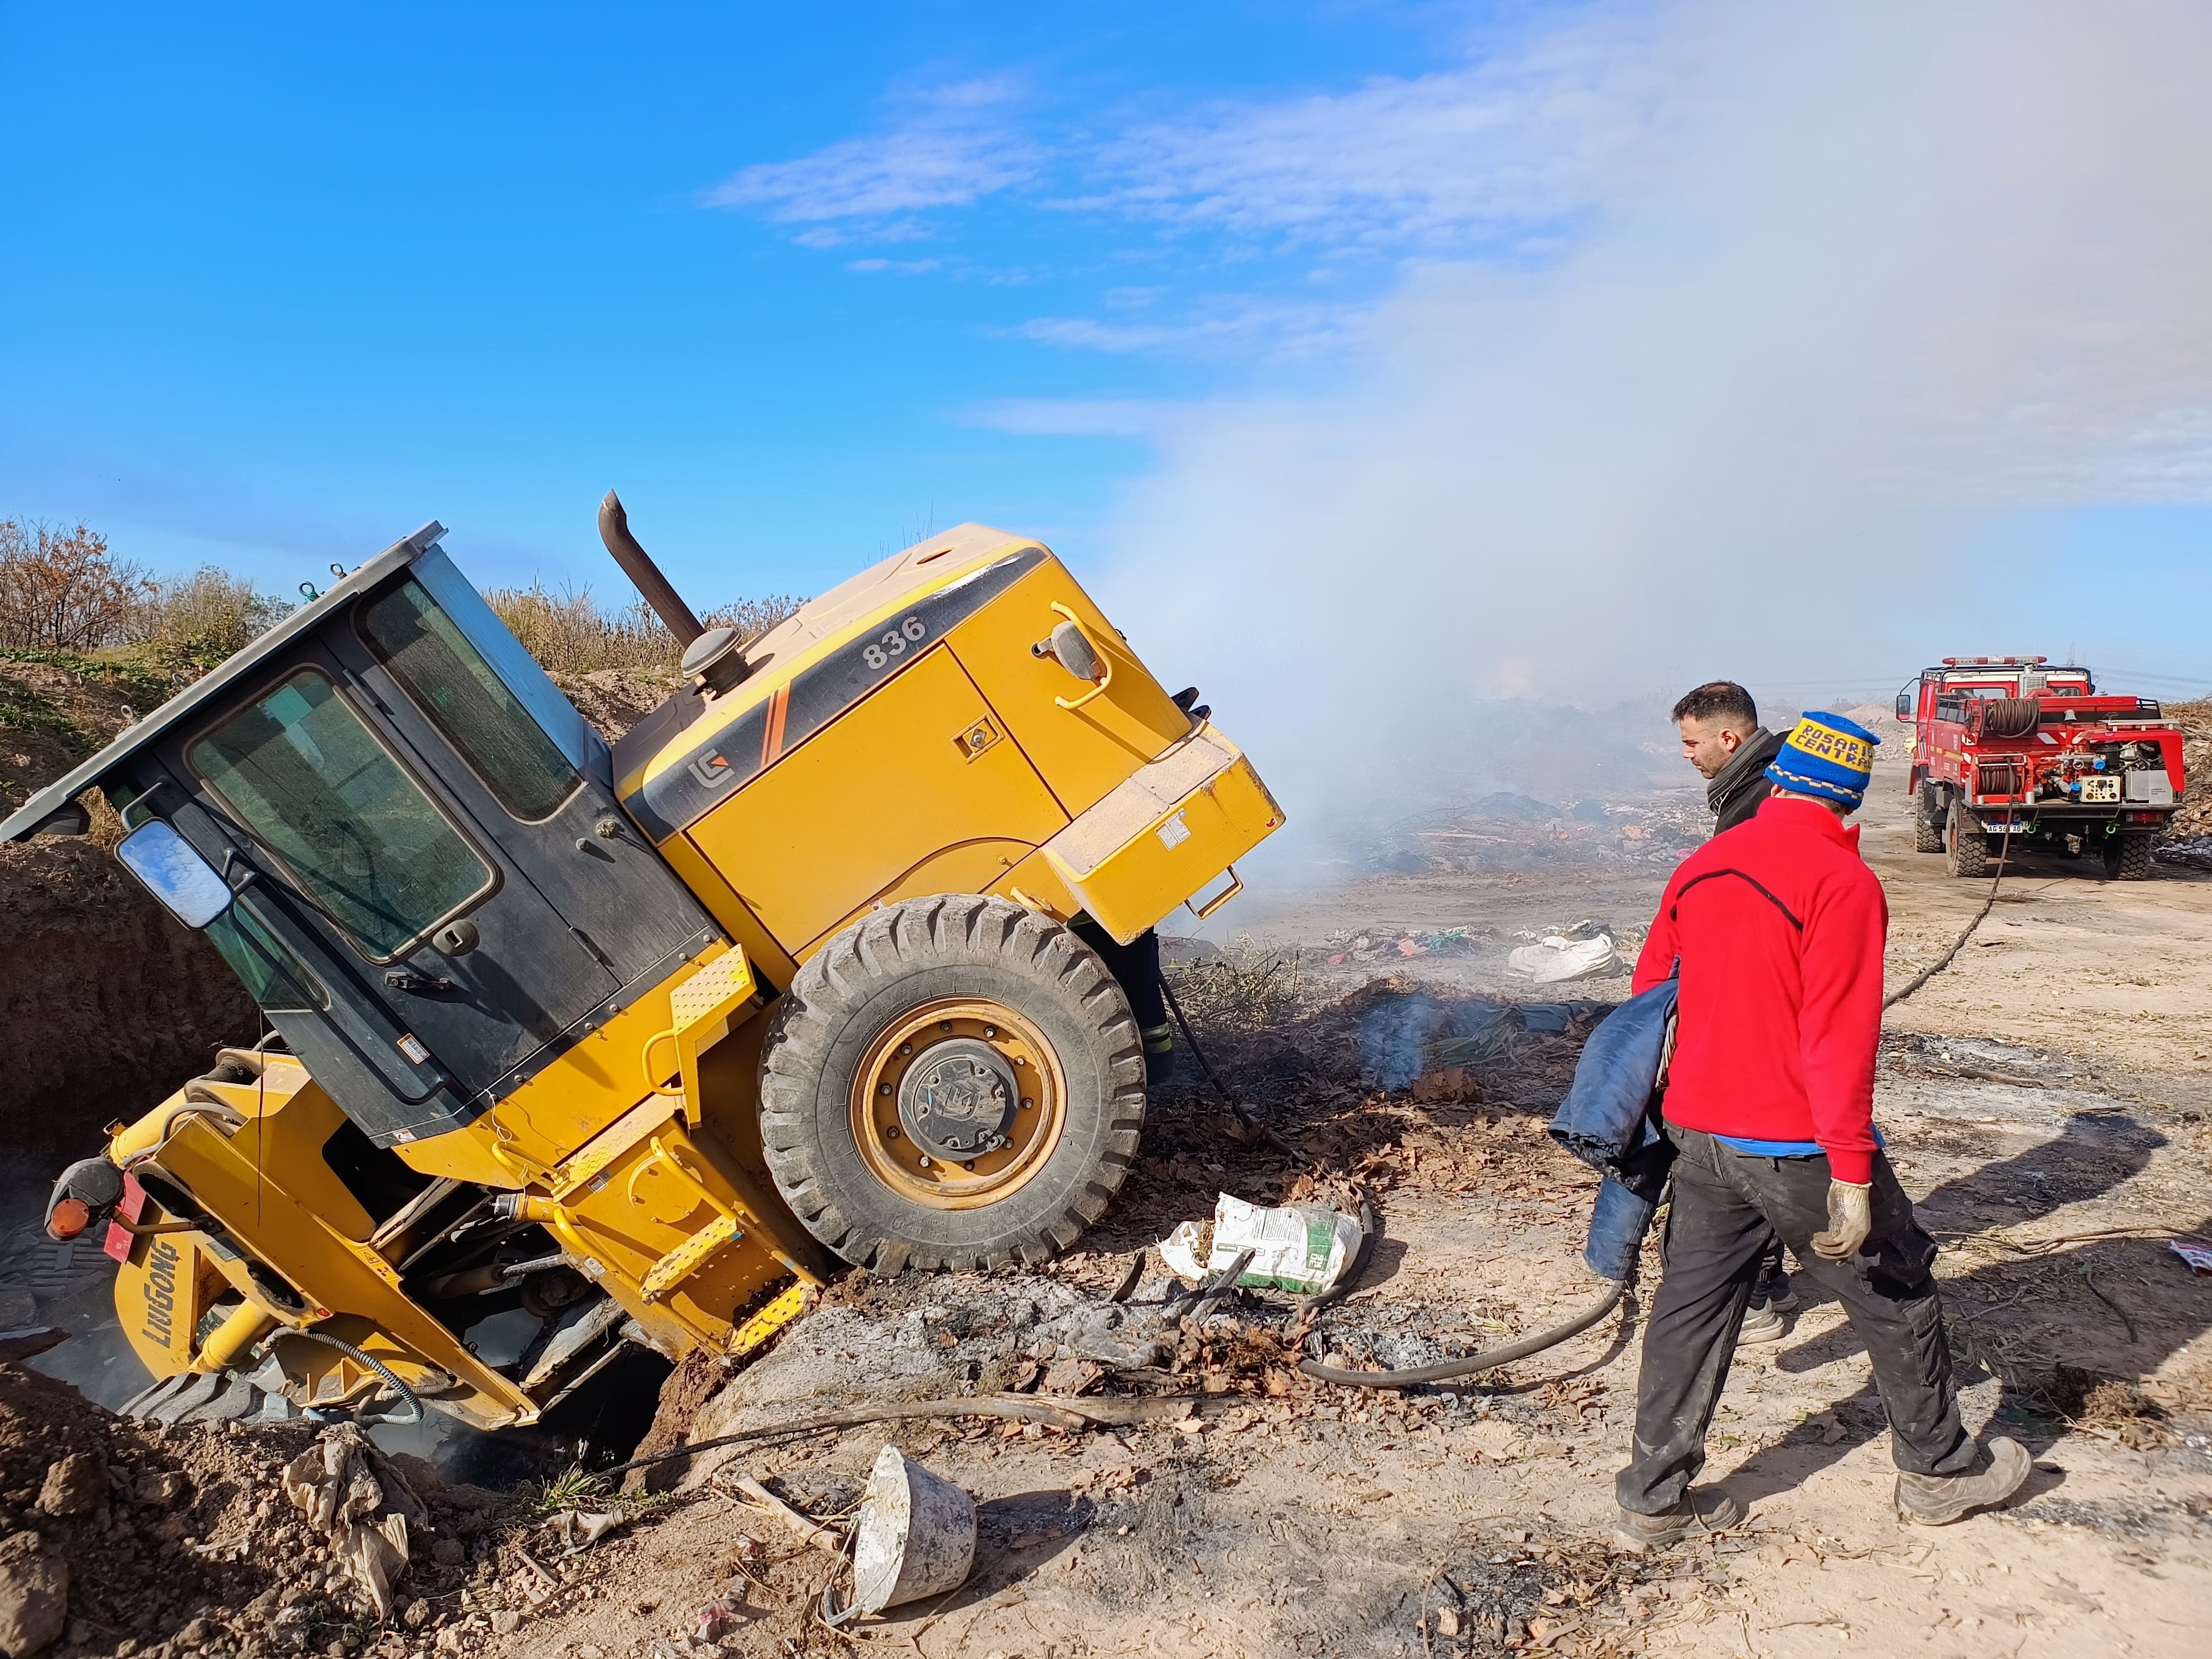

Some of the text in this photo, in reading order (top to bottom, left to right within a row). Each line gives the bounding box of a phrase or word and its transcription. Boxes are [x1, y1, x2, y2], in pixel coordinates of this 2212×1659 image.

[862, 616, 926, 669] 836
[1795, 734, 1872, 770] CENTRAL
[1802, 724, 1873, 759] ROSARIO
